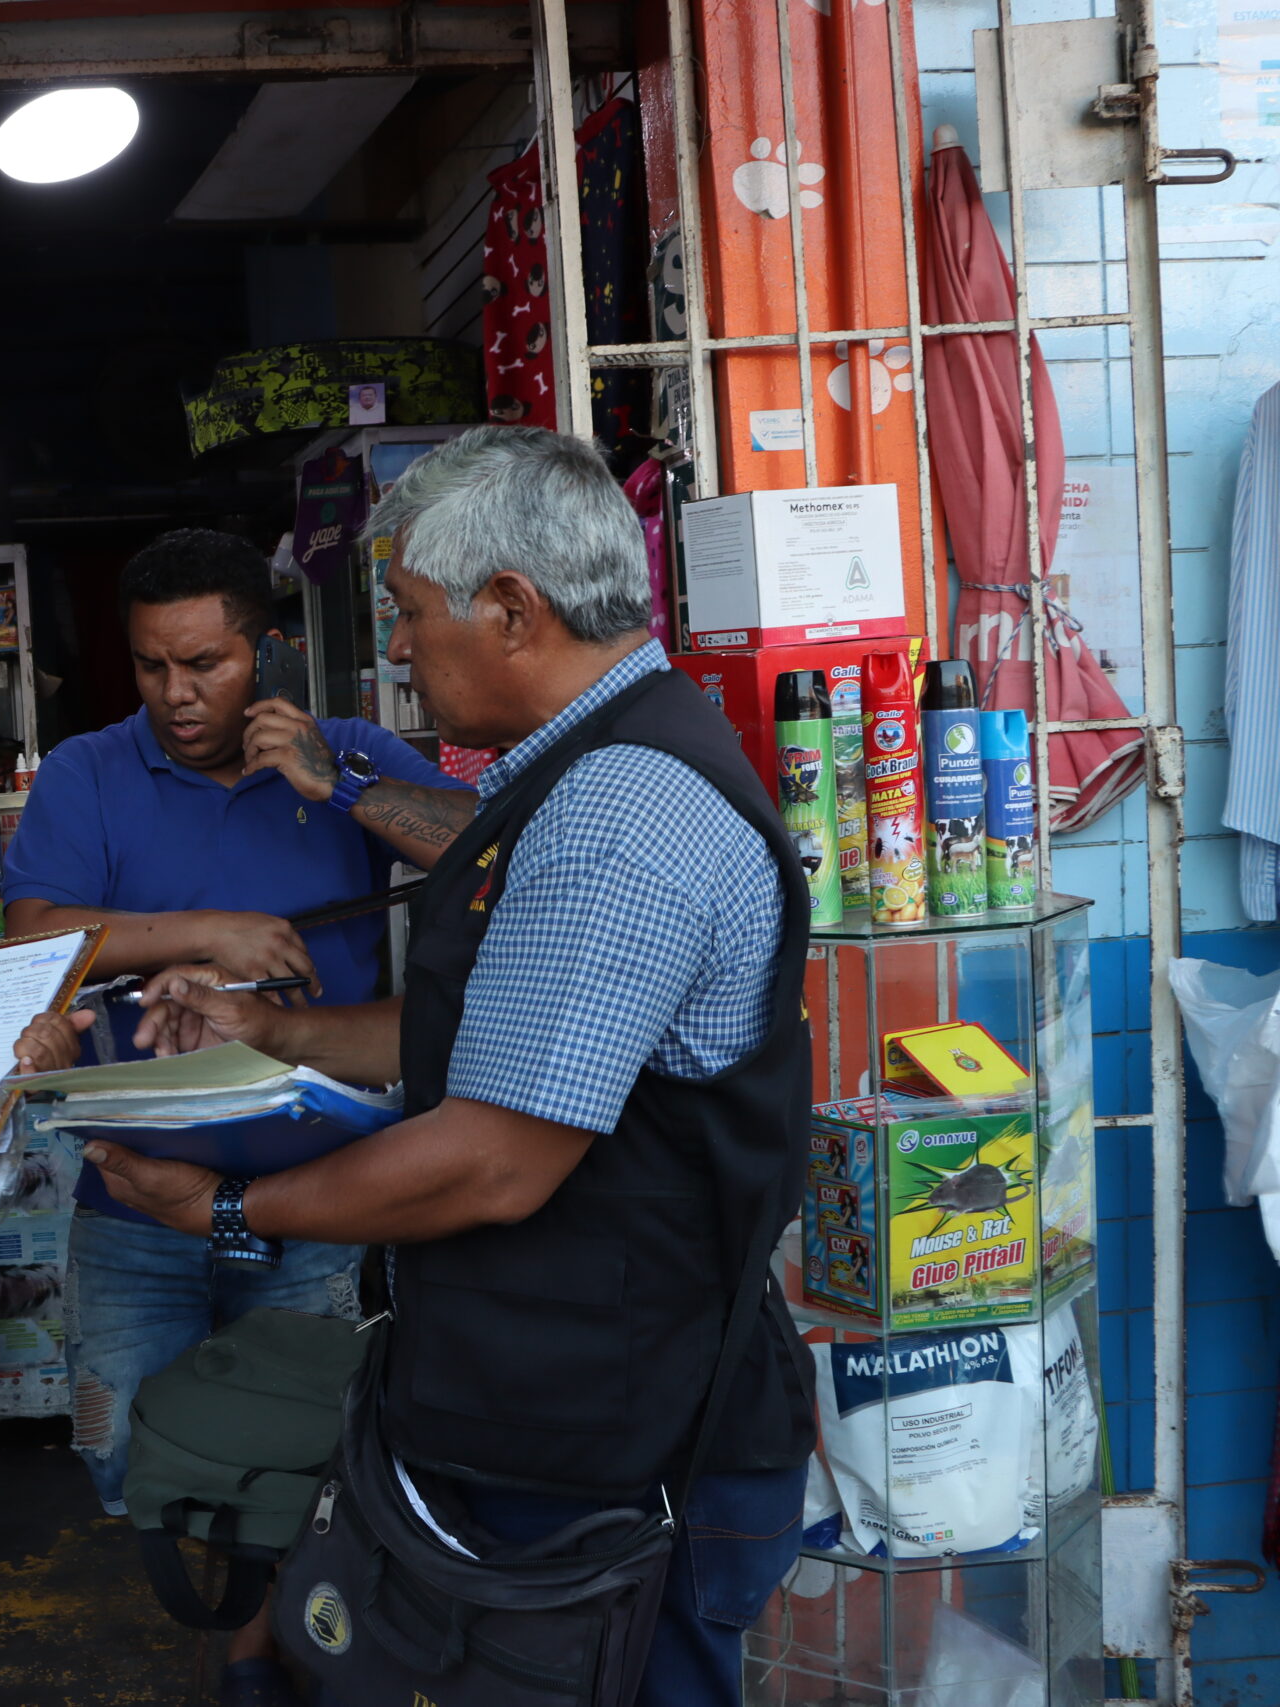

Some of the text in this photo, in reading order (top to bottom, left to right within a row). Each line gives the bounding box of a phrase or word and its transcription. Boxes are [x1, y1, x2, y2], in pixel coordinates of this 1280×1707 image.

[790, 502, 844, 513] Methomex
[302, 523, 343, 564] yape
[842, 593, 875, 605] ADAMA
[702, 674, 721, 683] Gallo
[876, 710, 902, 718] Gallo
[801, 761, 823, 771] FORTE
[941, 756, 980, 768] Punzón
[871, 788, 902, 802] MATA
[910, 1214, 1012, 1259] Mouse & Rat
[910, 1237, 1027, 1291] Glue Pitfall
[846, 1331, 1000, 1377] MALATHION
[902, 1410, 965, 1428] USO INDUSTRIAL
[908, 1431, 932, 1439] POLVO
